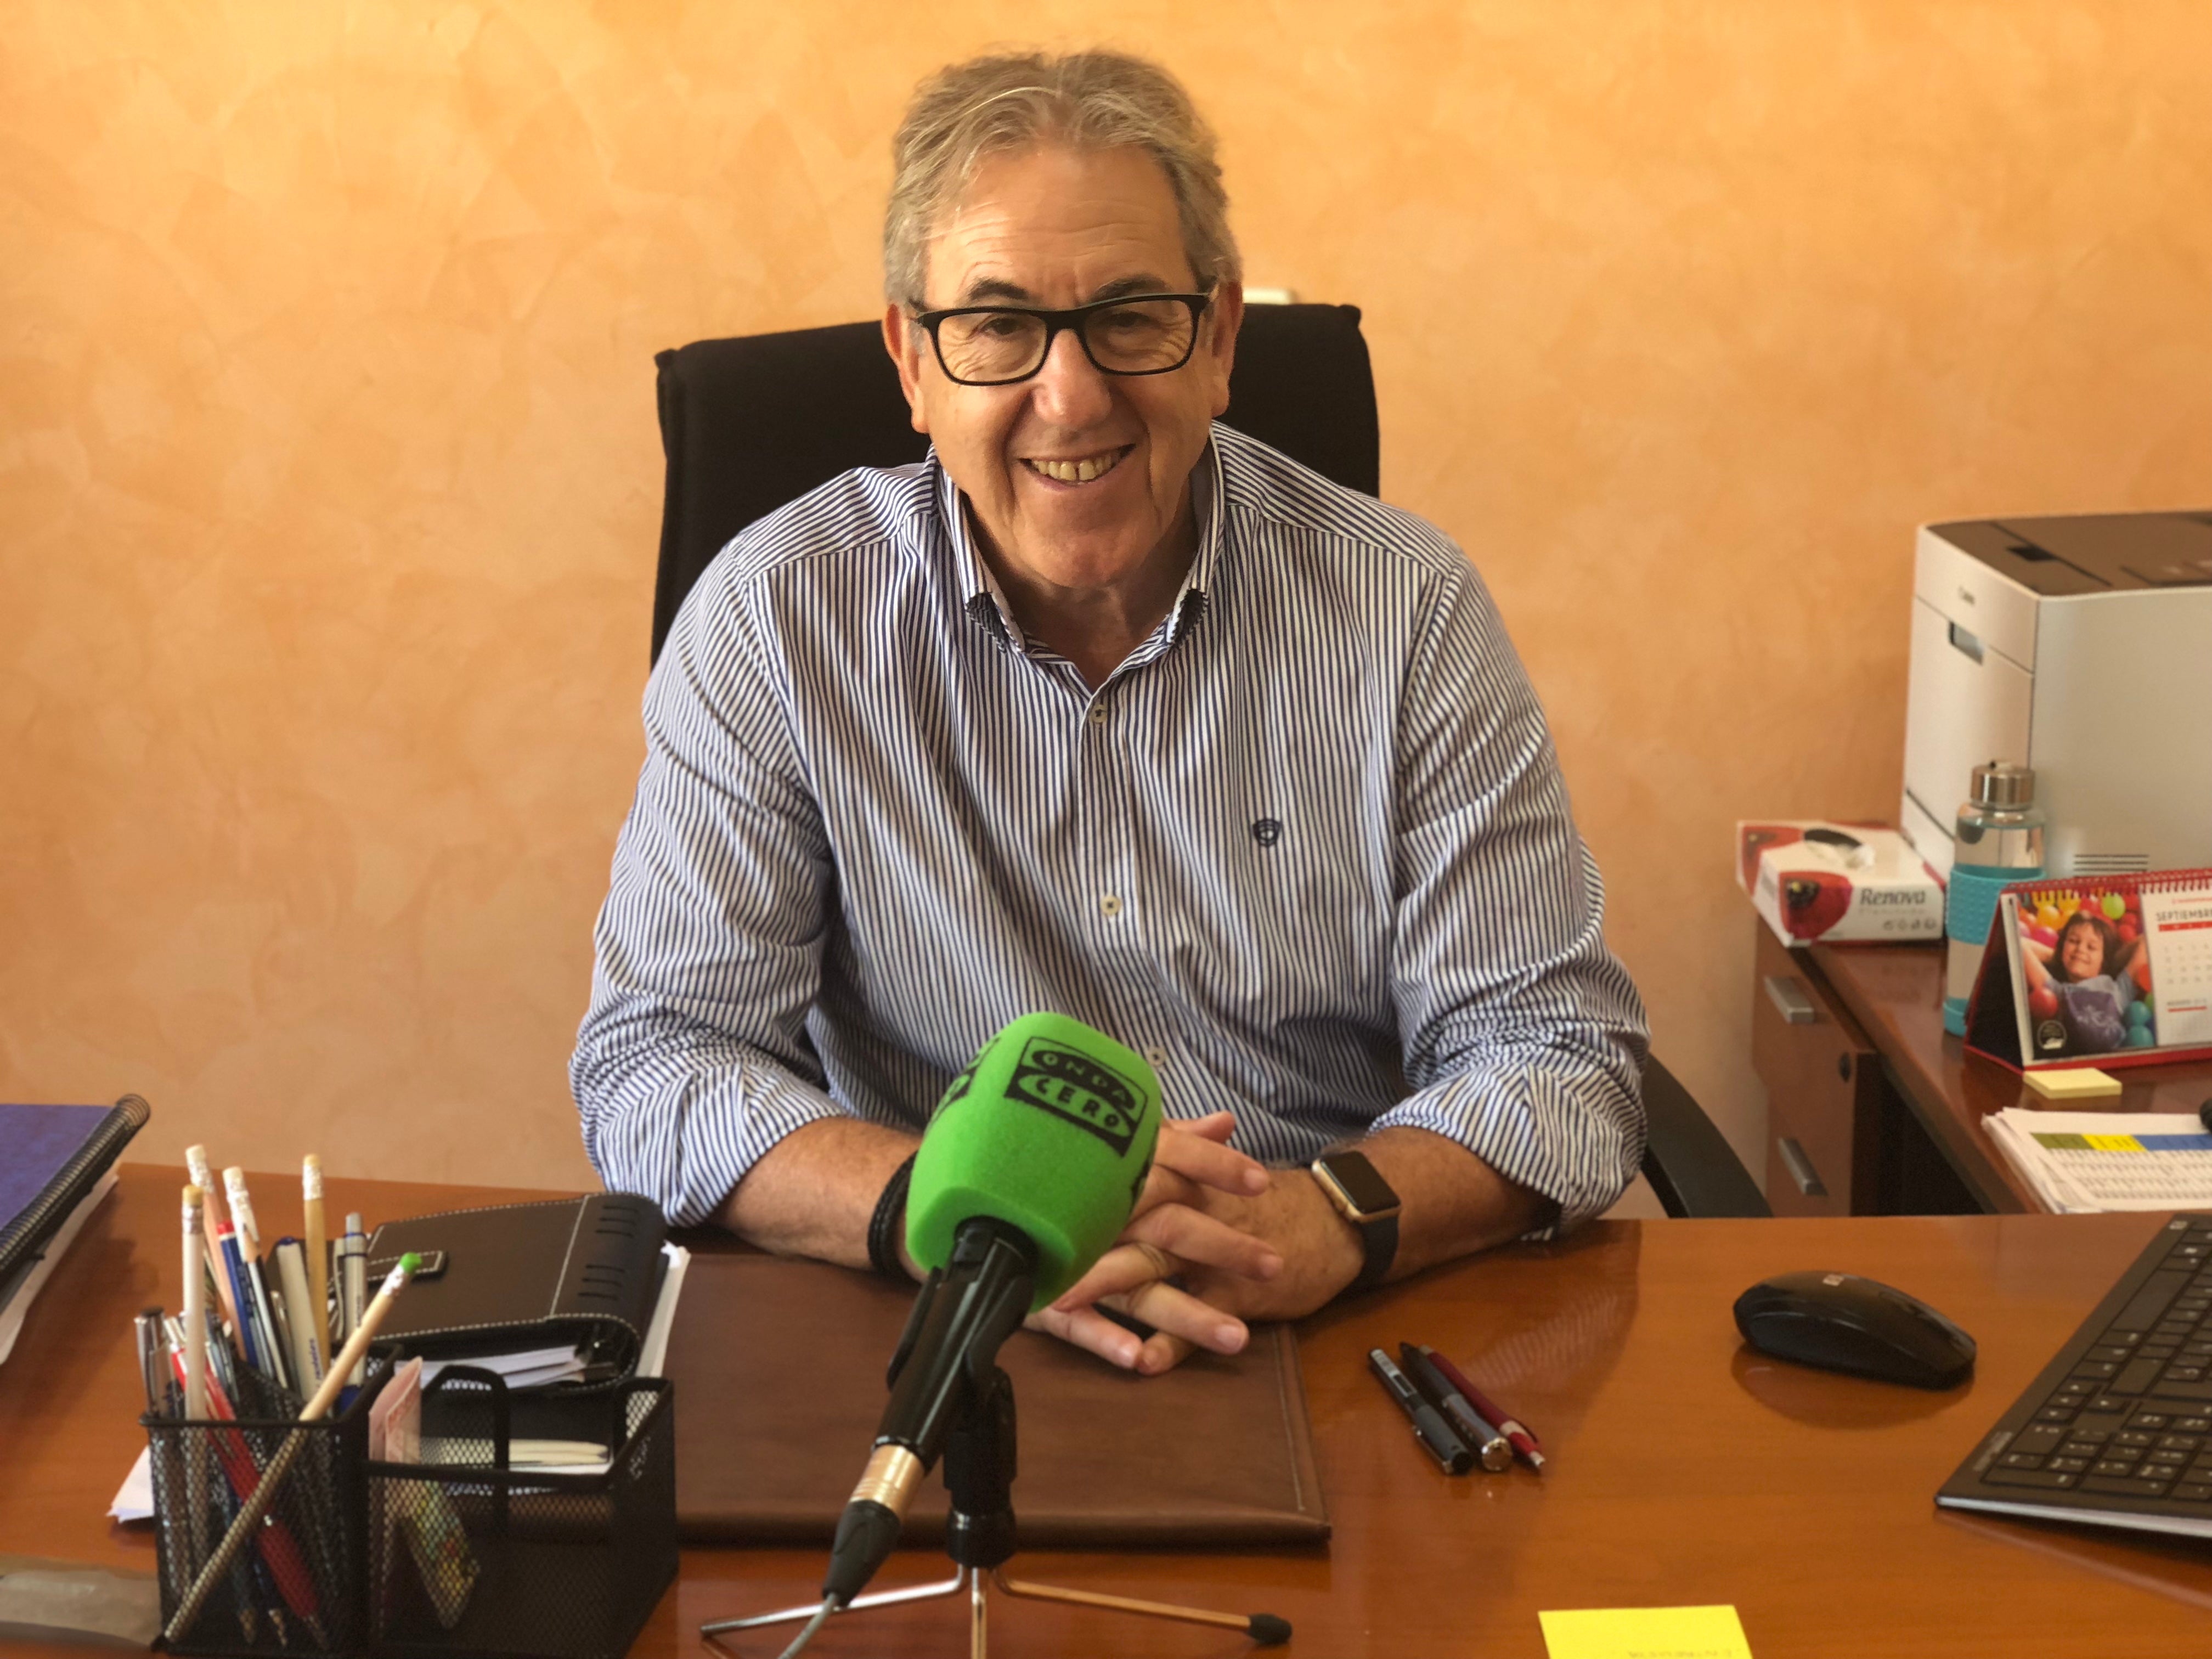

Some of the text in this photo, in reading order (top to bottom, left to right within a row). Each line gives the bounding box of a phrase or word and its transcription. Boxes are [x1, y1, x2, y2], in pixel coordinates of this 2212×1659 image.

[1860, 888, 1926, 905] Renova
[1036, 1077, 1119, 1127] CERO
[1043, 1053, 1128, 1107] ONDA
